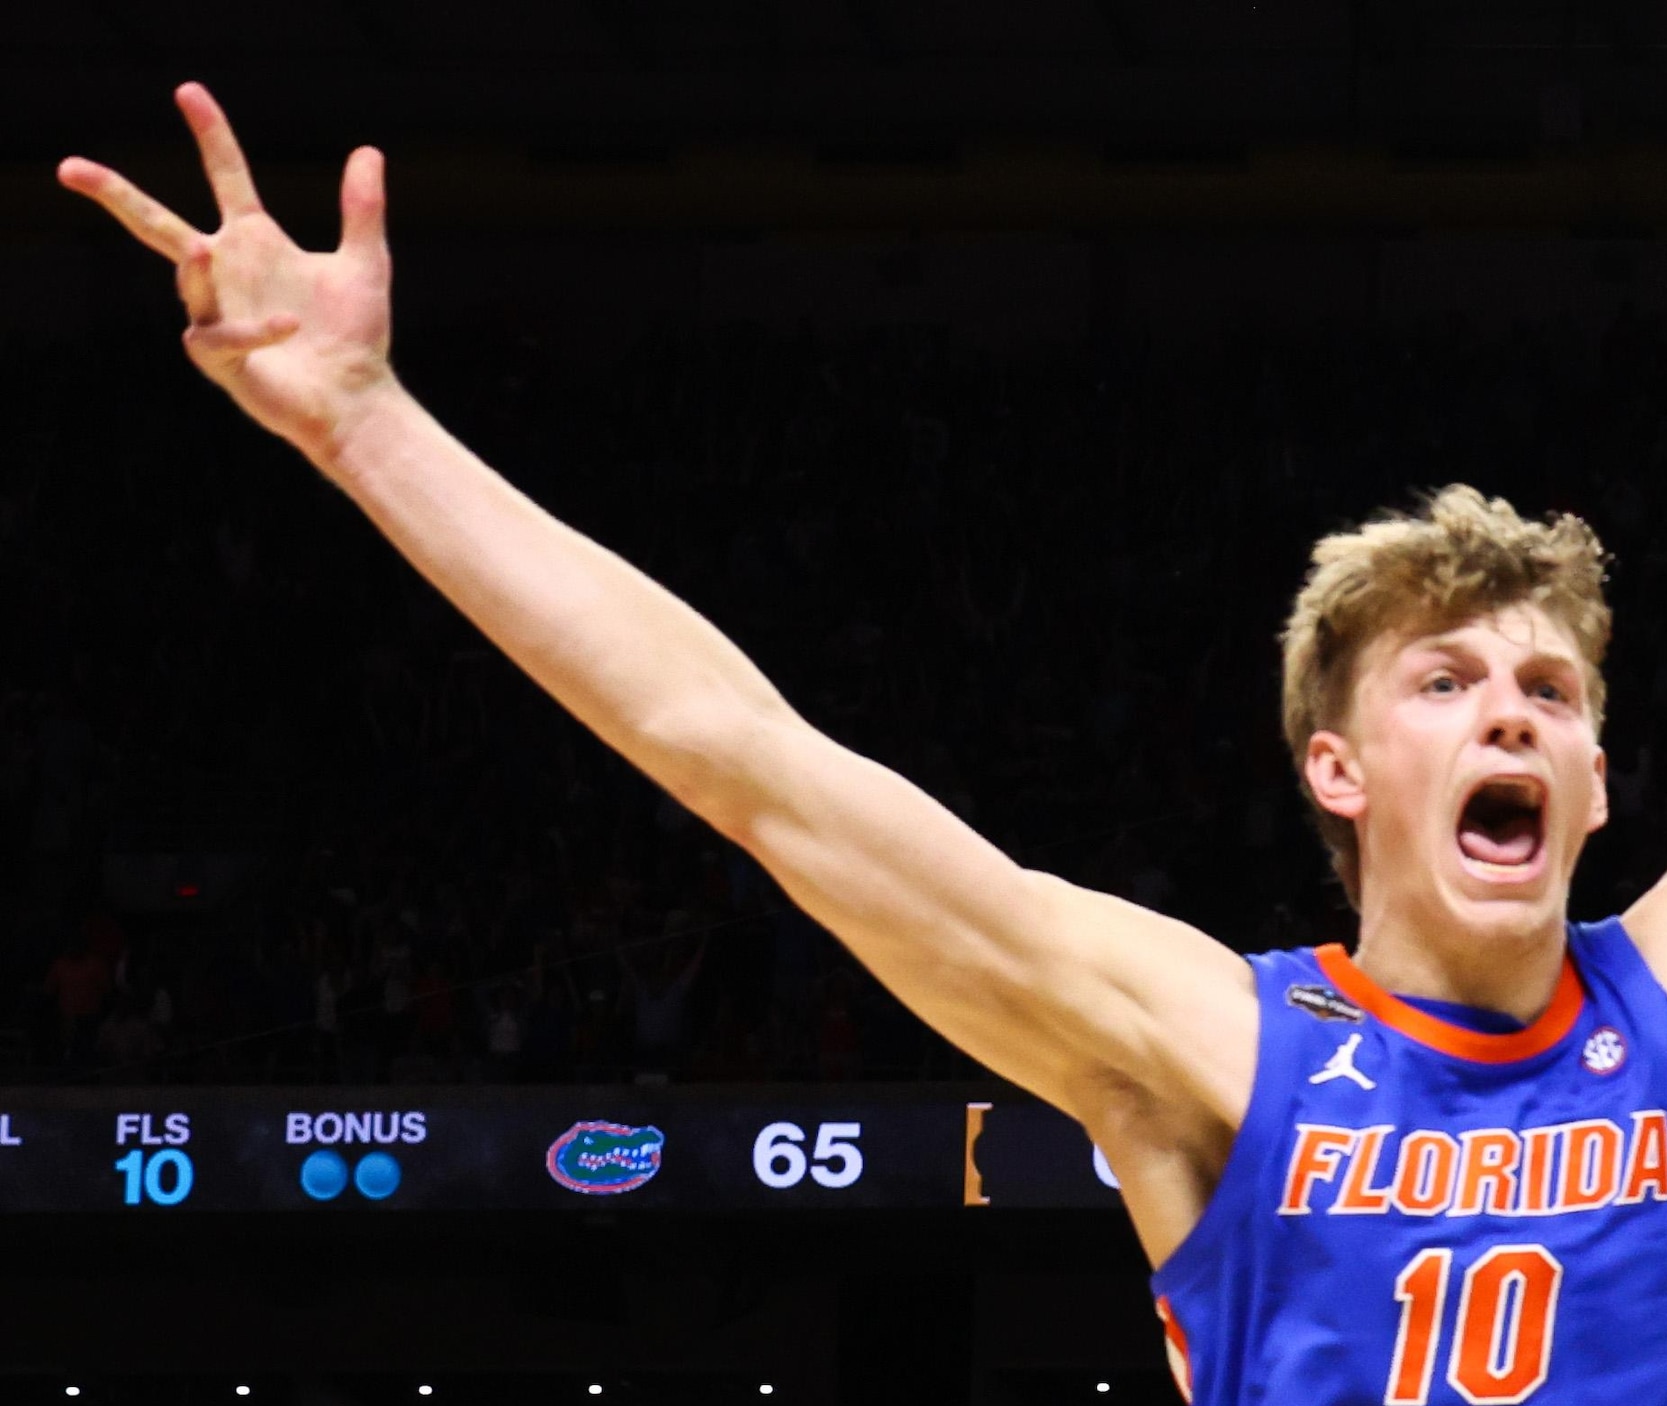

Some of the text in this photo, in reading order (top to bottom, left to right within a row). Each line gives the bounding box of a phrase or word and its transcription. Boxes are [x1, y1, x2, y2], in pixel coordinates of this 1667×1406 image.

[116, 1112, 191, 1145] FLS
[285, 1111, 427, 1145] BONUS
[114, 1148, 195, 1206] 10
[752, 1121, 864, 1189] 65
